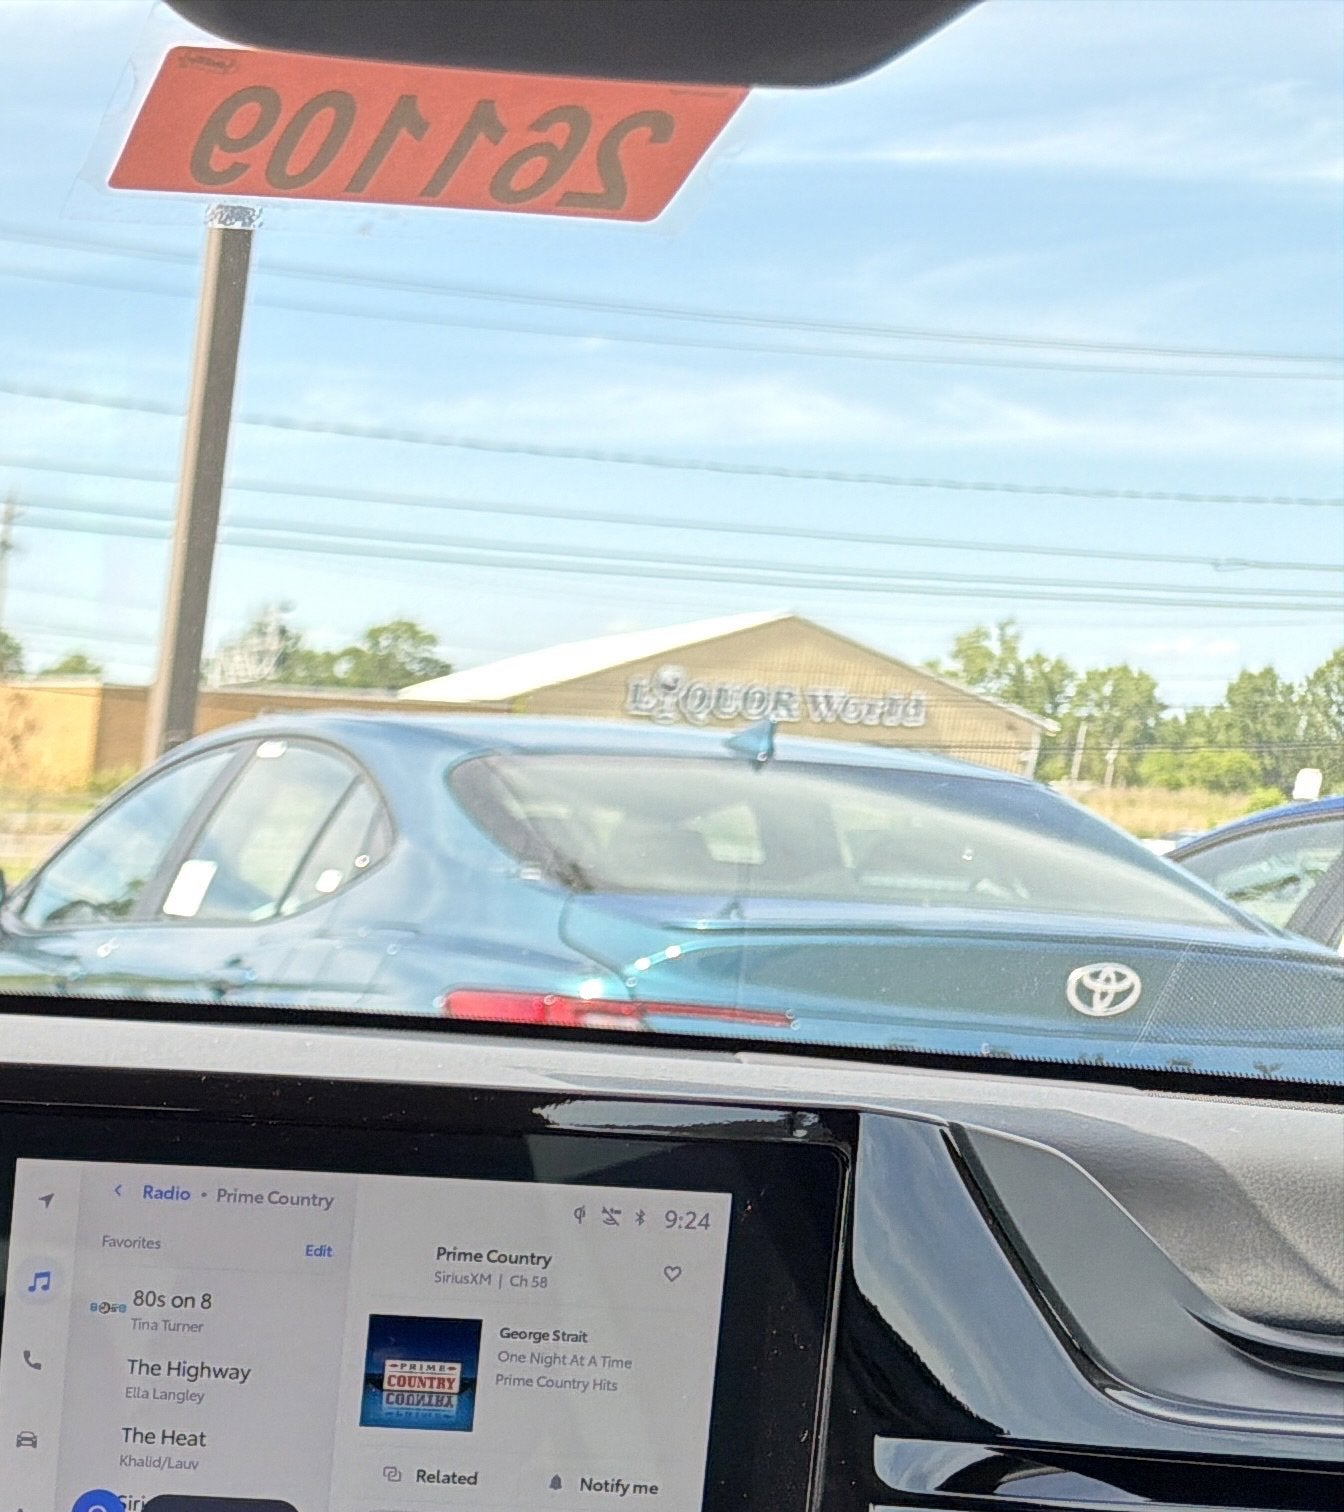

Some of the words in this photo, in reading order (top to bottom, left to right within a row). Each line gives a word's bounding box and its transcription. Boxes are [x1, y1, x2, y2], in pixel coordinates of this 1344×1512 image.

[143, 1184, 191, 1201] Radio
[216, 1188, 264, 1205] Prime
[267, 1190, 335, 1210] Country
[664, 1209, 711, 1231] 9:24
[101, 1235, 162, 1250] Favorites
[305, 1243, 333, 1258] Edit
[436, 1246, 483, 1263] Prime
[486, 1249, 552, 1269] Country
[433, 1271, 492, 1287] SiriusXM
[509, 1274, 529, 1288] Ch
[531, 1275, 548, 1289] 58
[132, 1289, 166, 1308] 80s
[171, 1295, 196, 1309] on
[200, 1293, 213, 1309] 8
[131, 1317, 158, 1332] Tina
[161, 1319, 205, 1333] Turner
[499, 1327, 550, 1345] George
[552, 1329, 589, 1344] Strait
[399, 1362, 447, 1373] PRIME
[497, 1350, 526, 1364] One
[529, 1352, 567, 1369] Night
[569, 1353, 586, 1367] At
[587, 1354, 598, 1367] A
[600, 1355, 633, 1370] Time
[127, 1358, 162, 1377] The
[166, 1360, 252, 1385] Highway
[386, 1374, 456, 1391] COUNTRY
[495, 1374, 534, 1388] Prime
[536, 1375, 590, 1392] Country
[592, 1378, 618, 1392] Hits
[125, 1386, 150, 1400] Ella
[152, 1388, 205, 1405] Langley
[121, 1427, 156, 1446] The
[161, 1429, 207, 1448] Heat
[119, 1454, 199, 1471] Khalid/Lauv
[415, 1468, 479, 1486] Related
[579, 1477, 631, 1497] Notify
[632, 1483, 660, 1496] me
